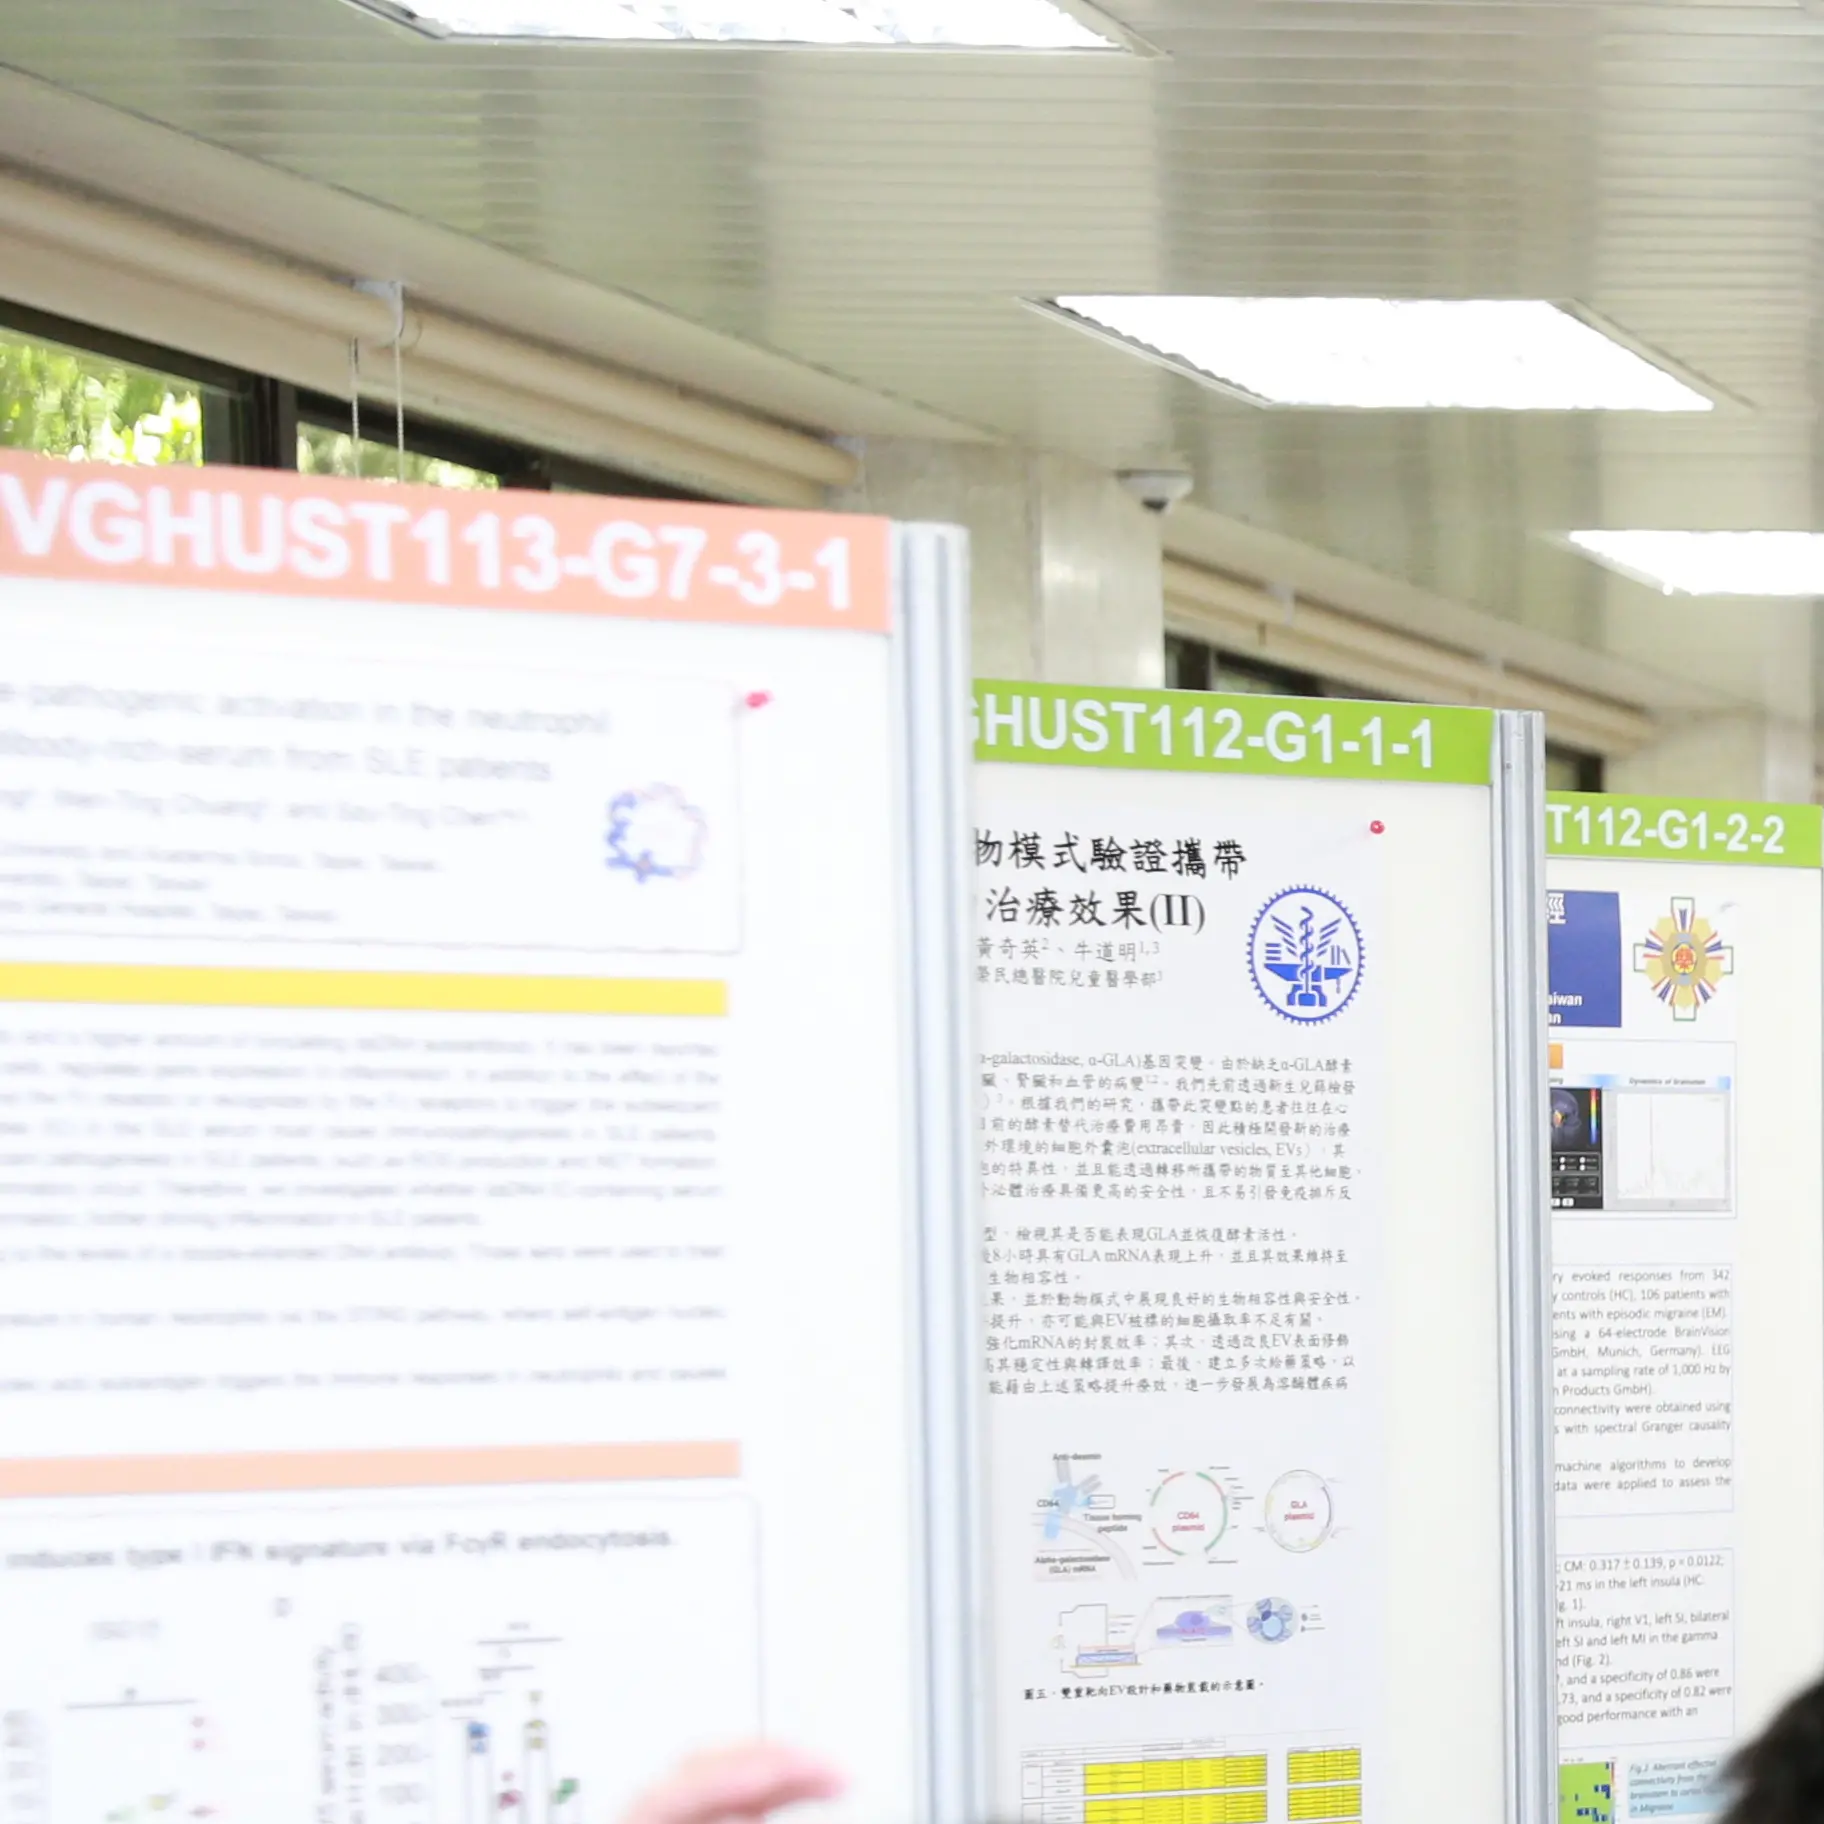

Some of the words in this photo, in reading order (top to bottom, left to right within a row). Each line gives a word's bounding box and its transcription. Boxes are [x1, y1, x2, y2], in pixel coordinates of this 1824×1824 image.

[1, 473, 852, 612] VGHUST113-G7-3-1
[1547, 803, 1786, 854] T112-G1-2-2
[985, 886, 1206, 936] 治療效果(II)
[1572, 1270, 1610, 1281] evoked
[1619, 1271, 1672, 1283] responses
[1680, 1269, 1705, 1281] from
[1712, 1269, 1729, 1281] 342
[1561, 1289, 1605, 1301] controls
[1641, 1289, 1660, 1301] 106
[1664, 1289, 1706, 1303] patients
[1709, 1288, 1729, 1300] with
[1580, 1308, 1603, 1320] with
[1607, 1307, 1651, 1321] episodic
[1654, 1307, 1699, 1322] migraine
[1557, 1367, 1568, 1378] at
[1581, 1364, 1630, 1380] sampling
[1634, 1365, 1654, 1376] rate
[1658, 1364, 1669, 1376] of
[1719, 1362, 1731, 1376] by
[1562, 1385, 1611, 1396] Products
[1554, 1403, 1620, 1417] connectivity
[1625, 1404, 1652, 1414] were
[1656, 1401, 1702, 1413] obtained
[1705, 1401, 1731, 1415] using
[1564, 1422, 1588, 1434] with
[1594, 1422, 1637, 1435] spectral
[1642, 1421, 1684, 1434] Granger
[1689, 1419, 1731, 1433] causality
[1555, 1460, 1601, 1473] machine
[1610, 1457, 1666, 1473] algorithms
[1674, 1458, 1685, 1469] to
[1693, 1456, 1731, 1471] develop
[1554, 1480, 1577, 1492] data
[1584, 1480, 1610, 1491] were
[1617, 1477, 1657, 1491] applied
[1662, 1477, 1673, 1489] to
[1679, 1476, 1710, 1487] assess
[1715, 1474, 1731, 1486] the
[1589, 1558, 1620, 1572] 0.317
[1576, 1580, 1592, 1590] ms
[1608, 1577, 1626, 1589] the
[1630, 1575, 1647, 1588] left
[1651, 1575, 1680, 1587] insula
[1568, 1615, 1603, 1629] insula,
[1607, 1613, 1631, 1629] right
[1655, 1612, 1672, 1624] left
[1690, 1609, 1730, 1623] bilateral
[1587, 1635, 1607, 1646] and
[1610, 1633, 1628, 1646] left
[1661, 1630, 1679, 1642] the
[1681, 1630, 1718, 1644] gamma
[1567, 1672, 1587, 1685] and
[1600, 1670, 1653, 1685] specificity
[1656, 1669, 1667, 1681] of
[1695, 1667, 1719, 1677] were
[1581, 1691, 1602, 1703] and
[1615, 1688, 1668, 1704] specificity
[1671, 1687, 1681, 1699] of
[1708, 1685, 1732, 1696] were
[1557, 1711, 1584, 1725] good
[1587, 1707, 1657, 1724] performance
[1660, 1705, 1683, 1718] with
[1686, 1706, 1698, 1717] an
